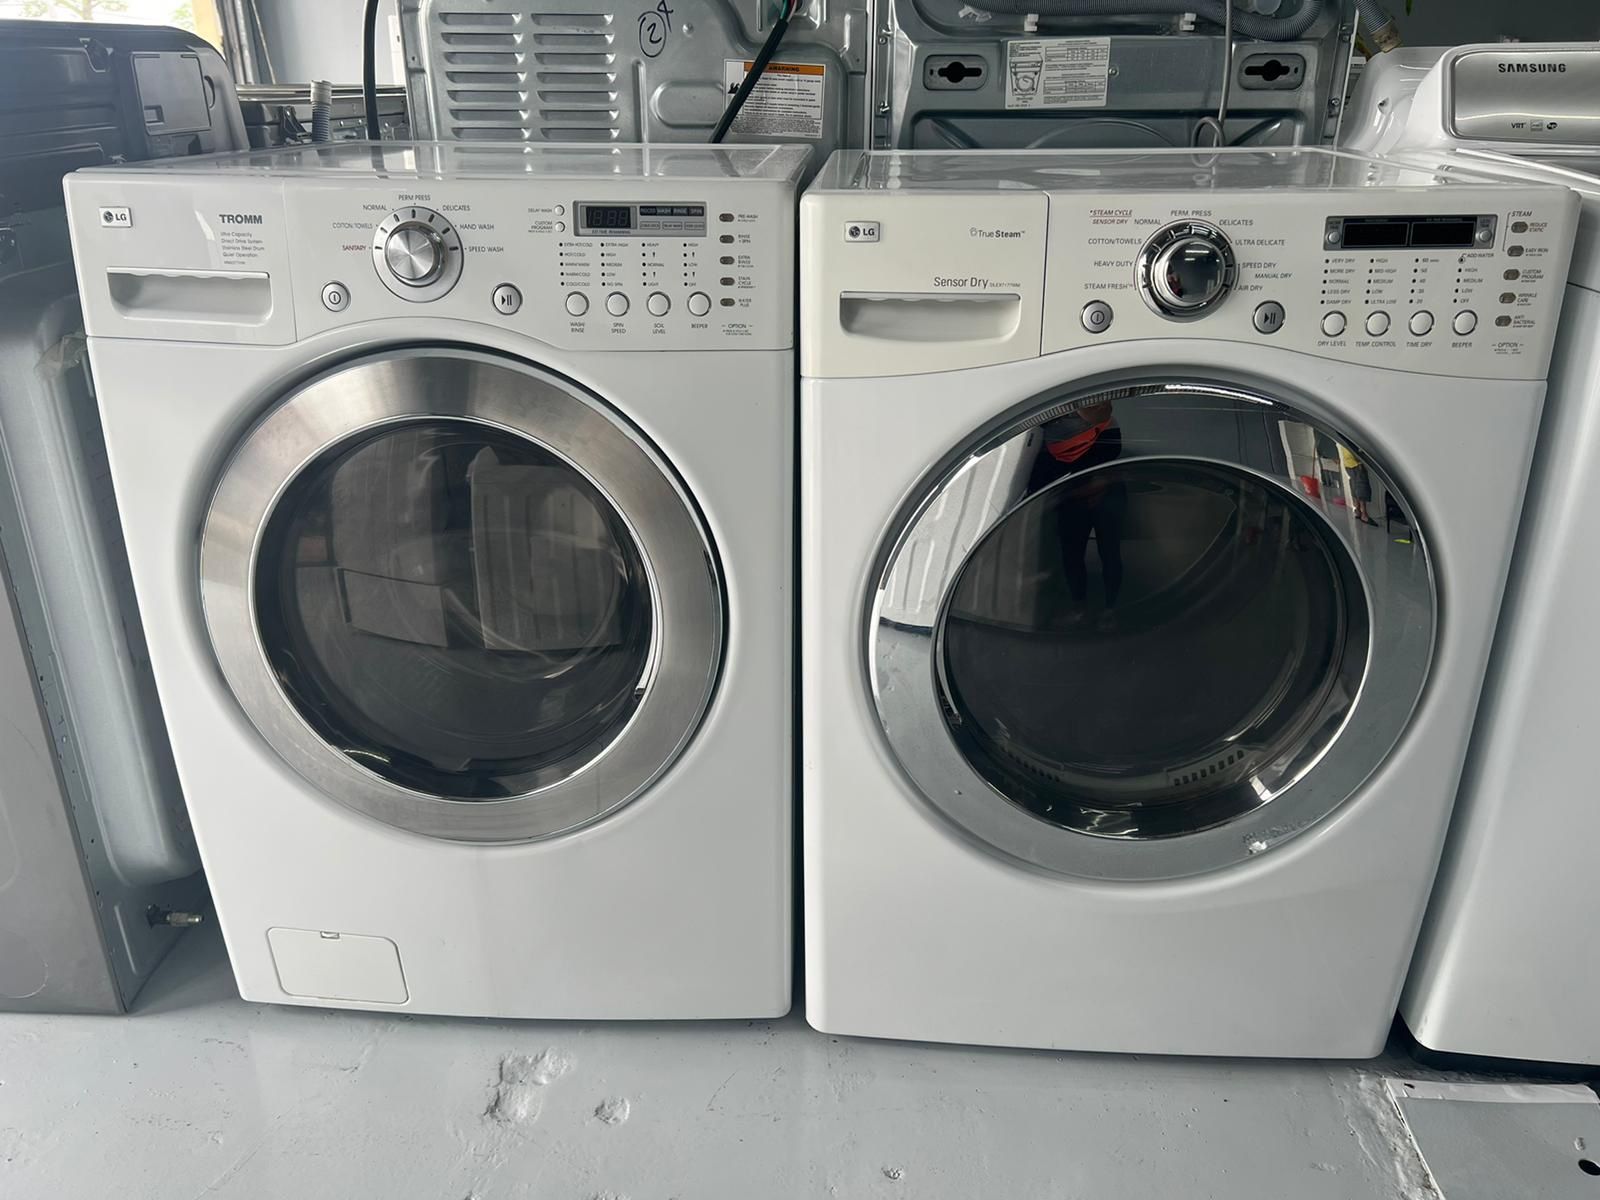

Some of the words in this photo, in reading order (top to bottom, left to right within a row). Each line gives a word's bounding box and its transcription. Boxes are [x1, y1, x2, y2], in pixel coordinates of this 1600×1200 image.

[1498, 63, 1567, 73] SAMSUNG
[115, 213, 127, 221] LG
[219, 214, 263, 225] TROMM
[862, 228, 875, 236] LG
[934, 276, 968, 288] Sensor
[970, 276, 989, 289] Dry
